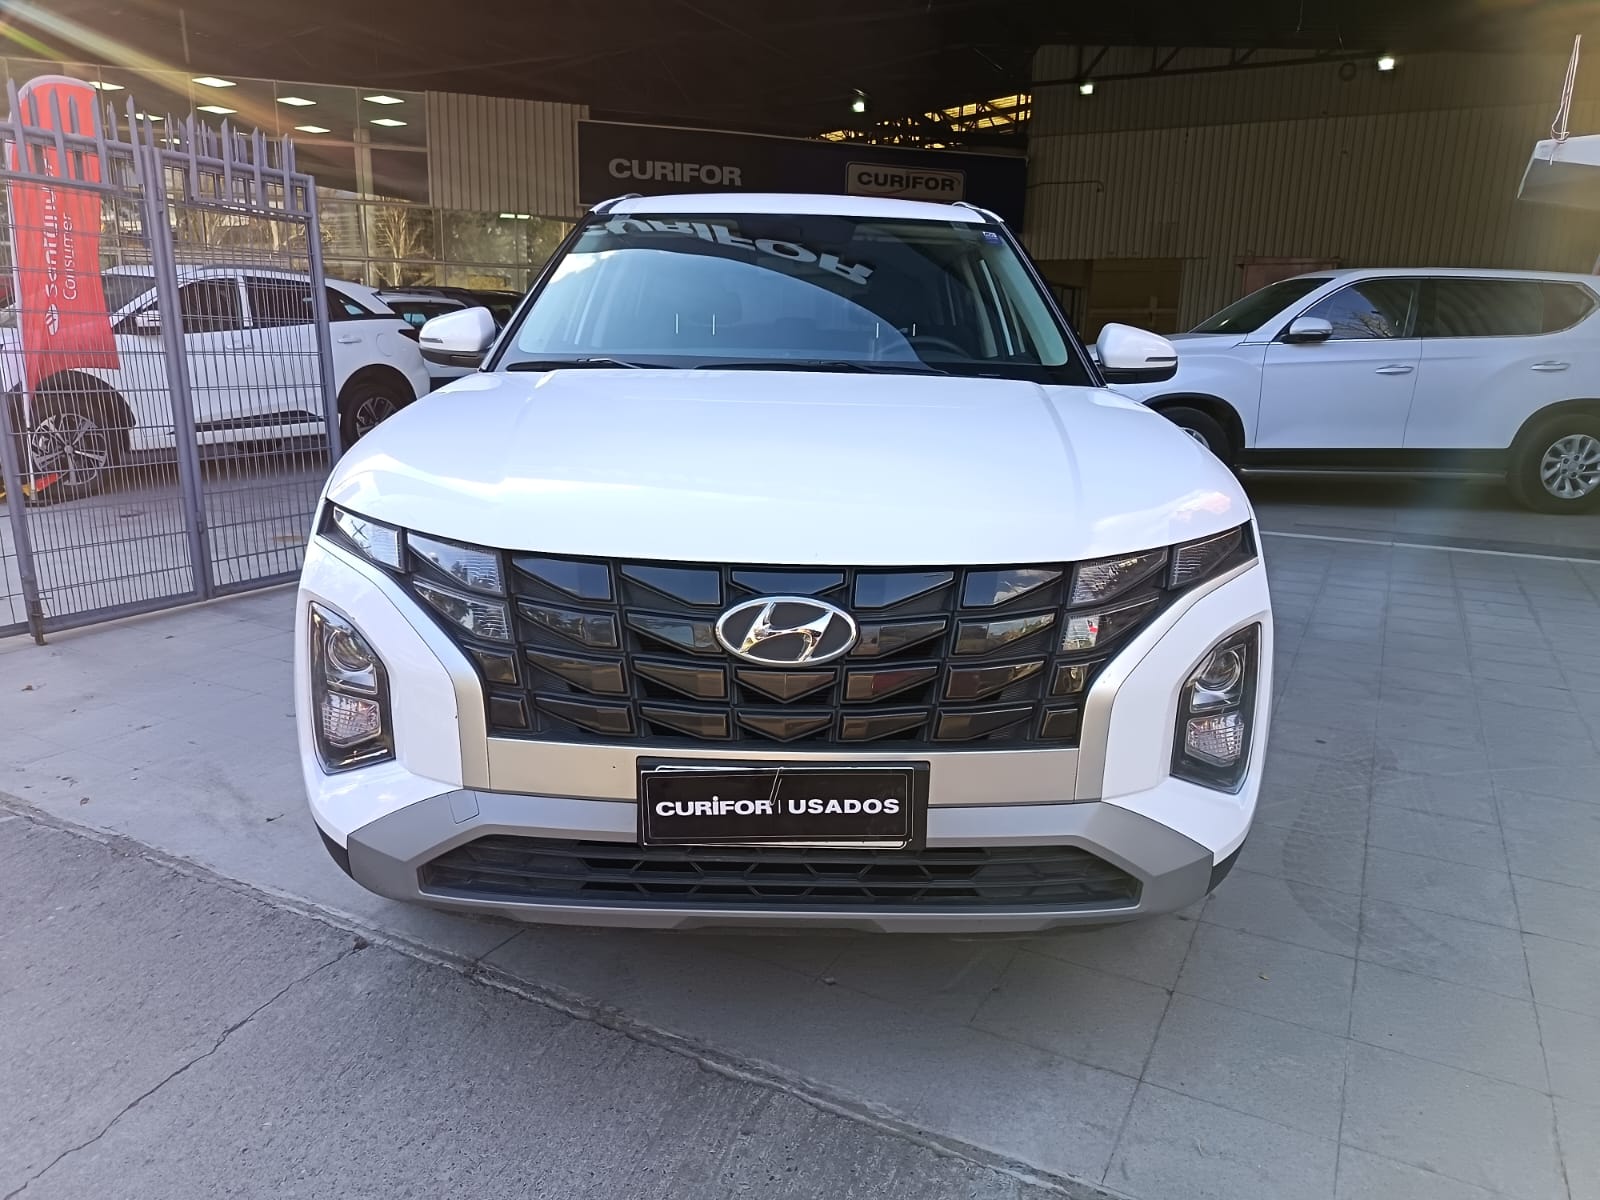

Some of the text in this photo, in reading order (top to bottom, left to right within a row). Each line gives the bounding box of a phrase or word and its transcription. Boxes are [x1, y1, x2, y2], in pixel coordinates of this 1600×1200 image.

[608, 158, 742, 187] CURIFOR
[62, 213, 78, 301] Consumer
[788, 799, 899, 814] USADOS
